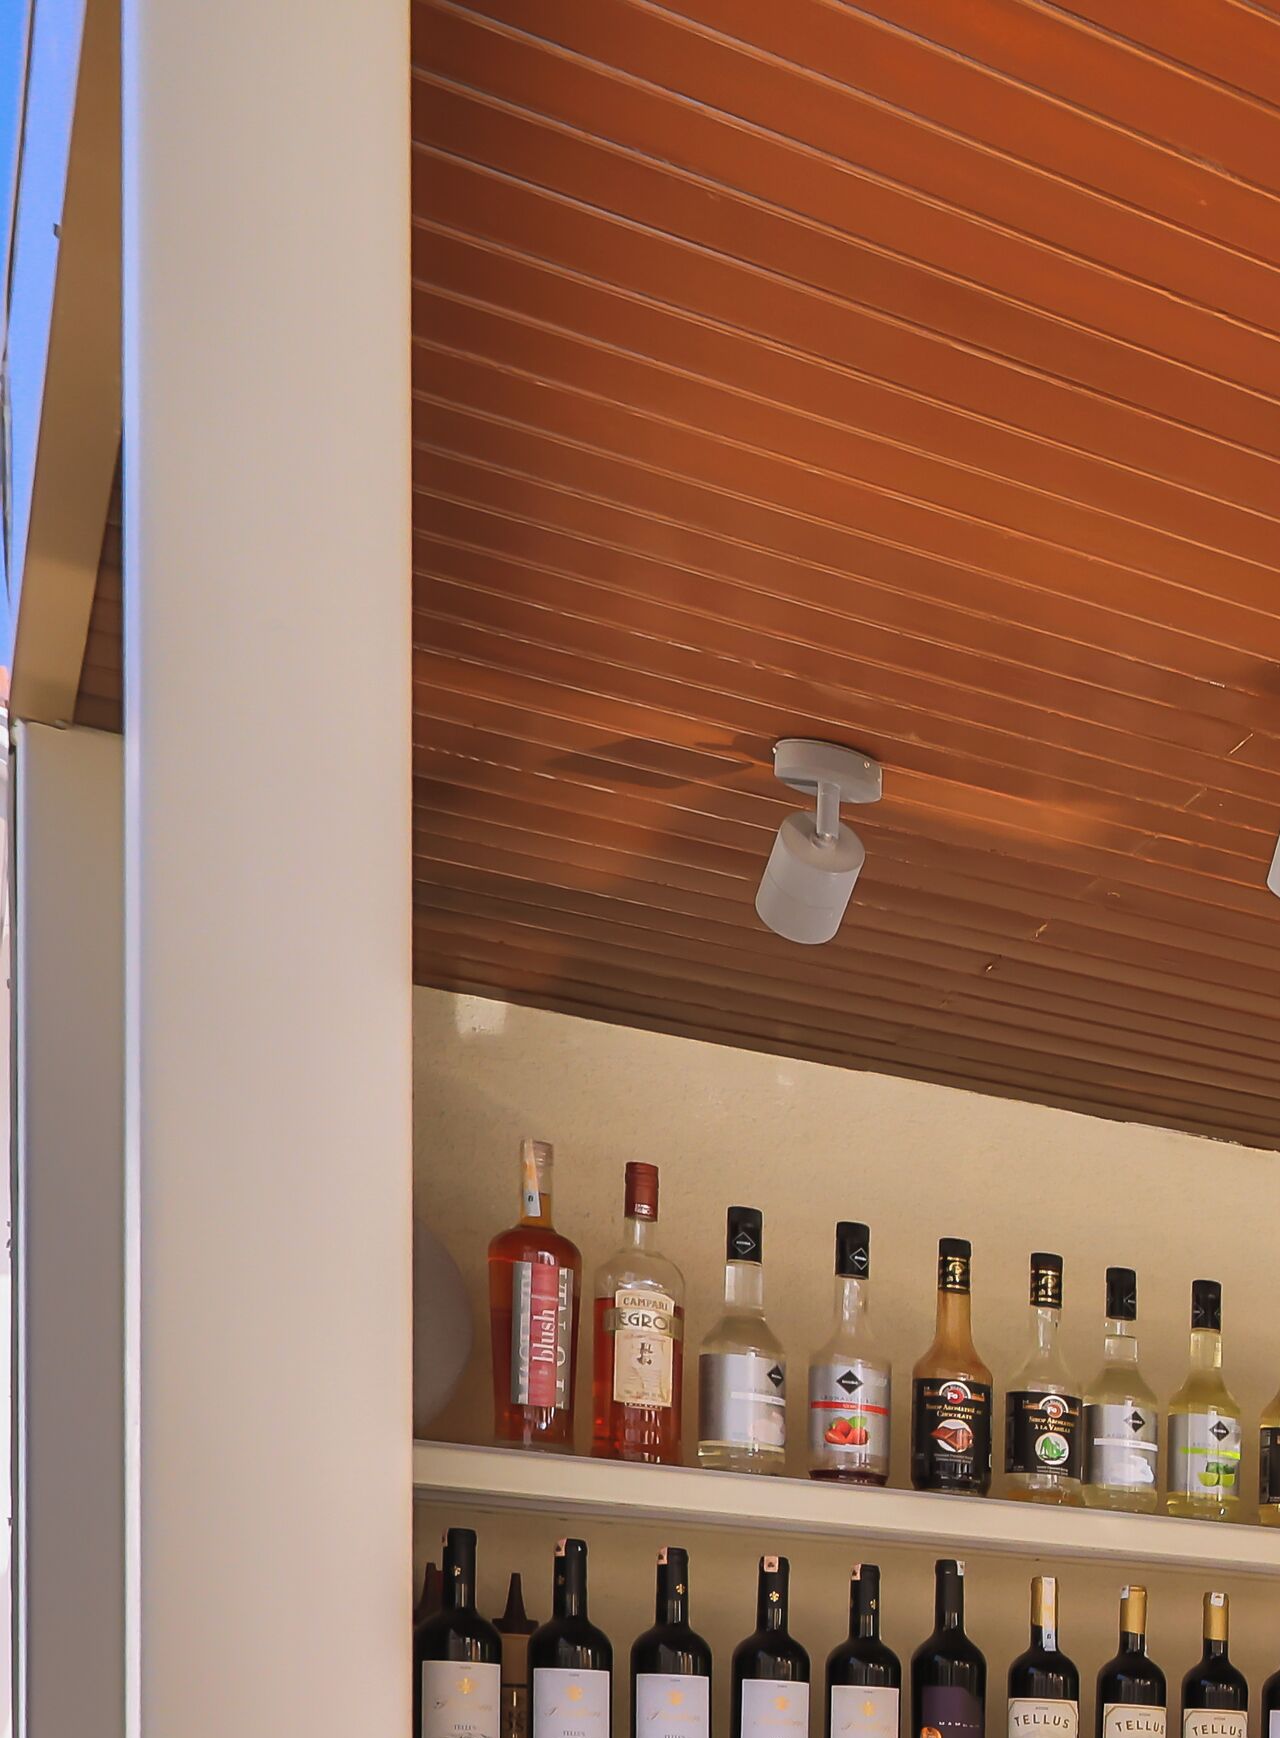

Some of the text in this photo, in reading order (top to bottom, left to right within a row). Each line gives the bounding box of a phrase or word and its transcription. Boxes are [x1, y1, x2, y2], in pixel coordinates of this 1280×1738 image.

[620, 1311, 671, 1331] EGRO
[531, 1308, 557, 1364] blush
[1014, 1713, 1071, 1729] TELLUS
[1115, 1719, 1165, 1735] TELLUS
[1192, 1723, 1243, 1738] TELLUS
